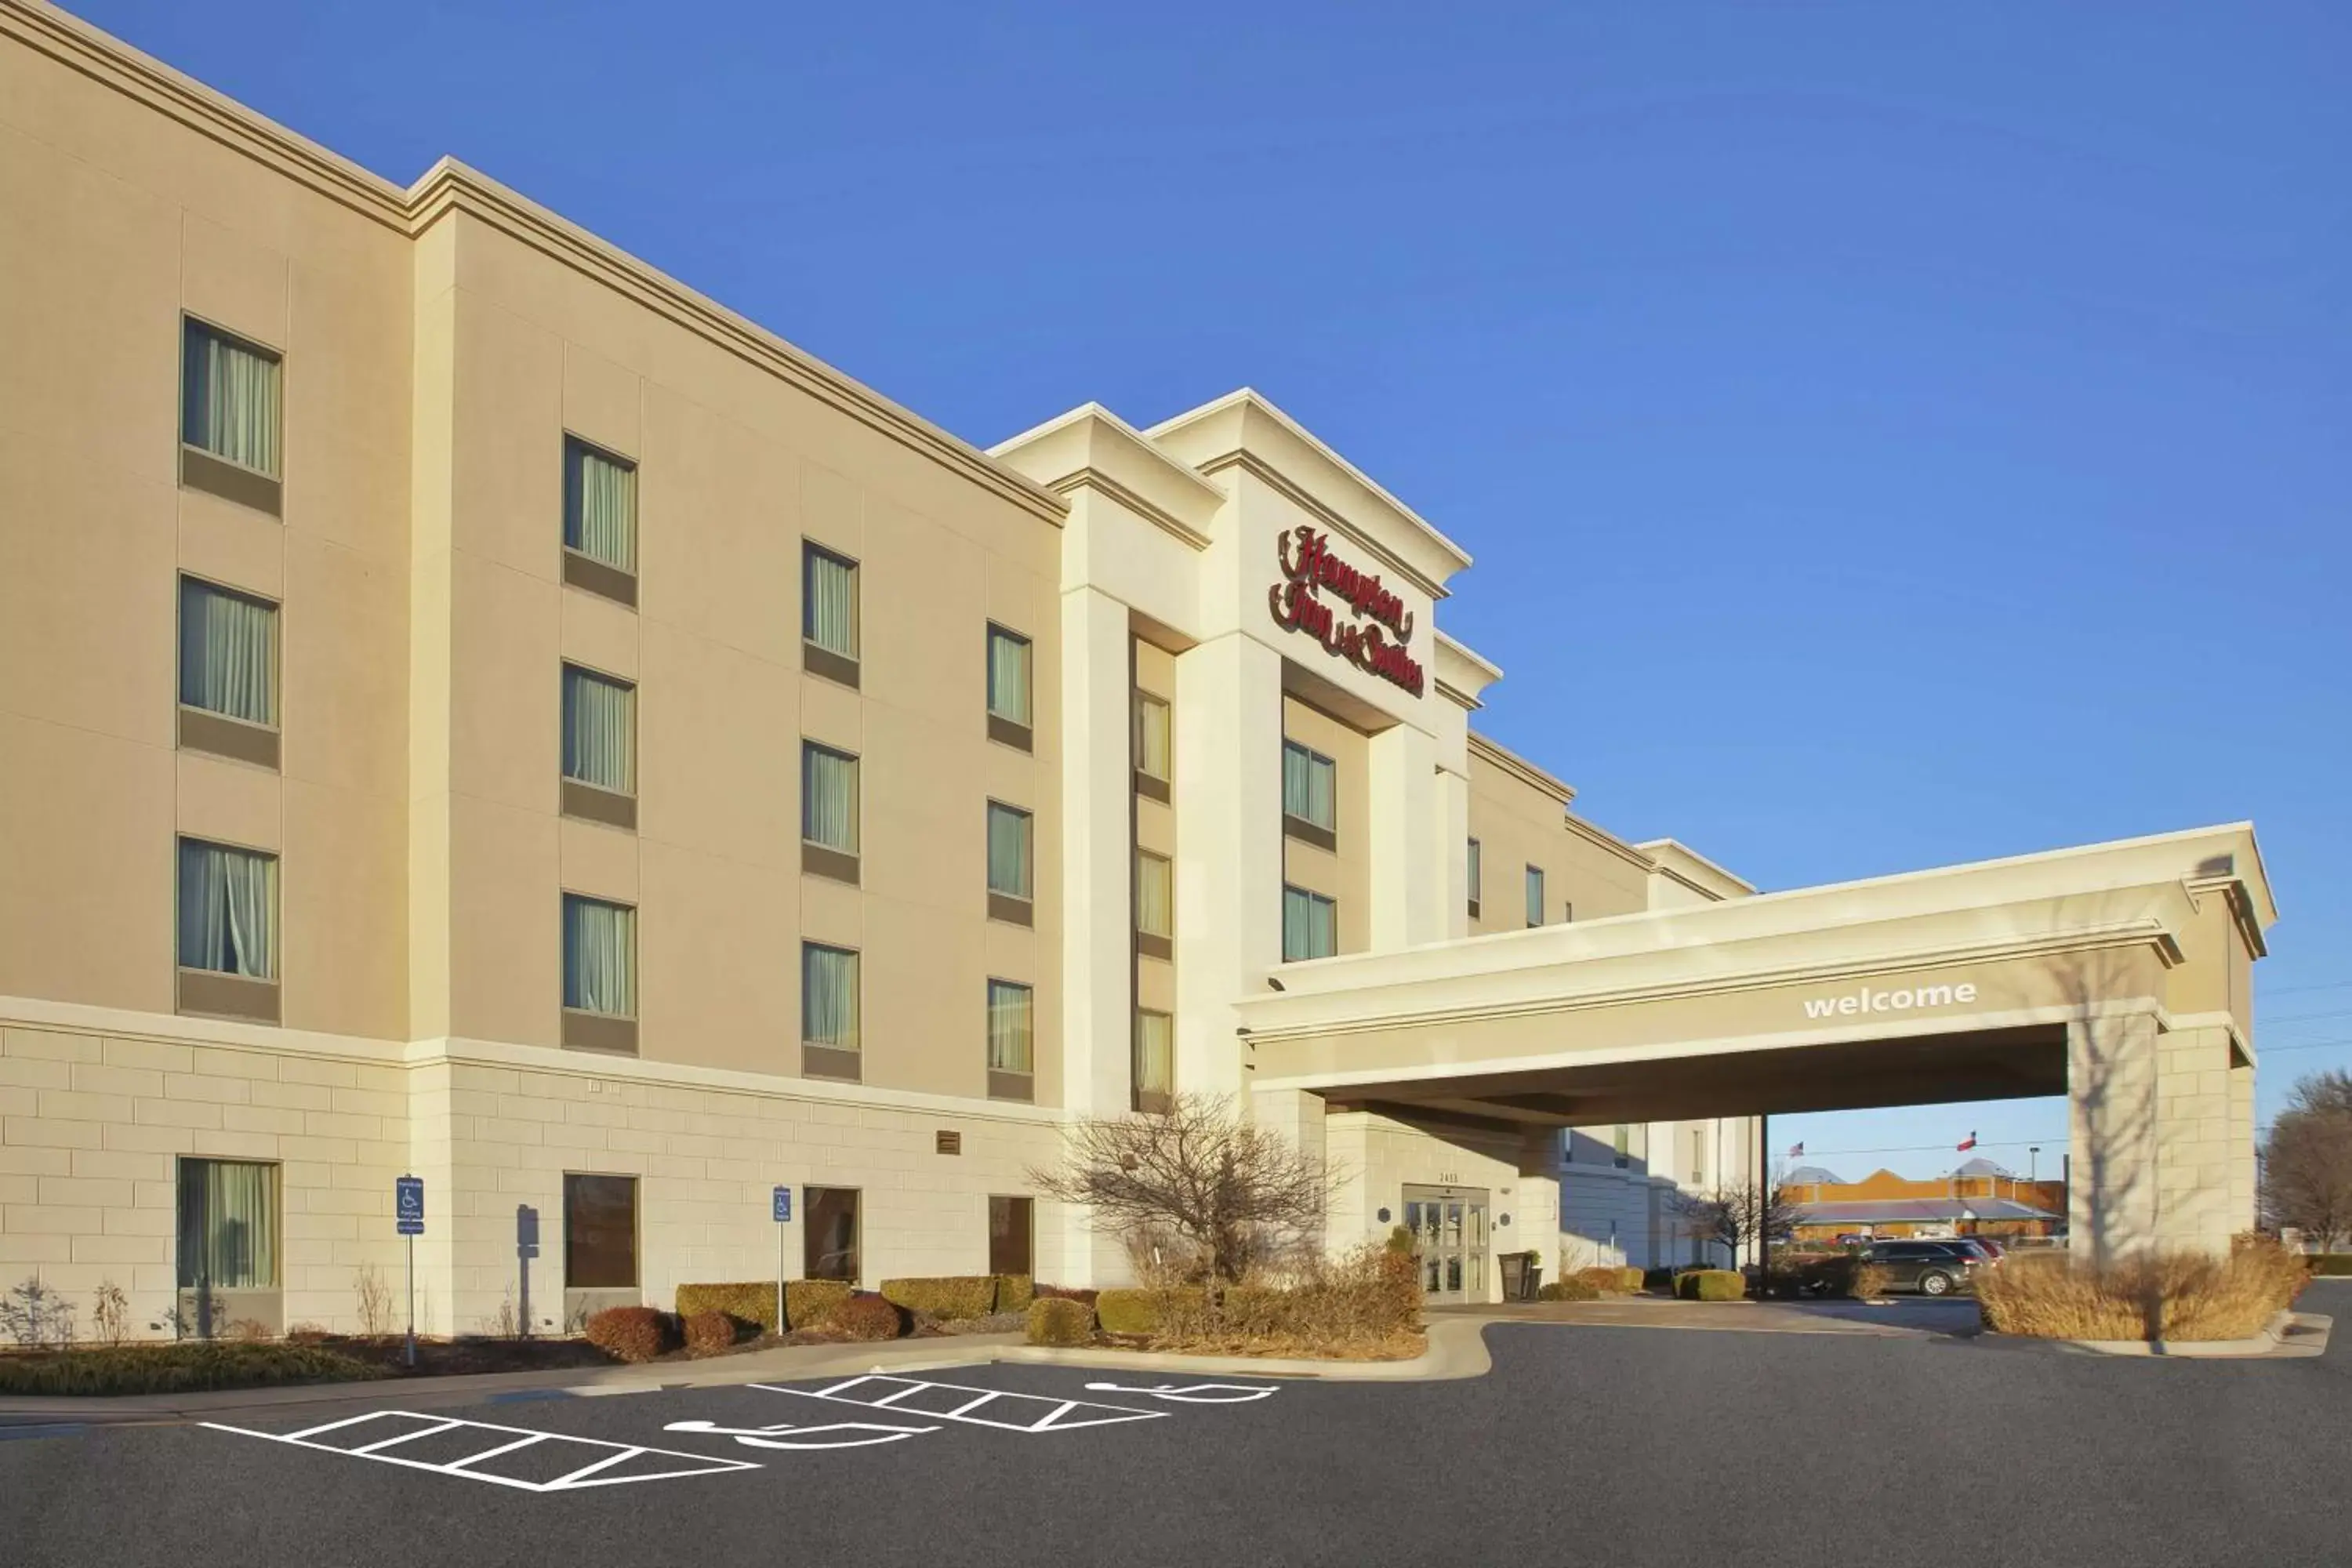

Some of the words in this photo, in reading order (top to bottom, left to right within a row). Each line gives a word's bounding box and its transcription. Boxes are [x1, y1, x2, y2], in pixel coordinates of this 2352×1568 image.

[1269, 583, 1344, 657] Inn
[1359, 623, 1424, 699] Suites
[1278, 525, 1414, 644] Hampton
[1804, 982, 1977, 1018] welcome
